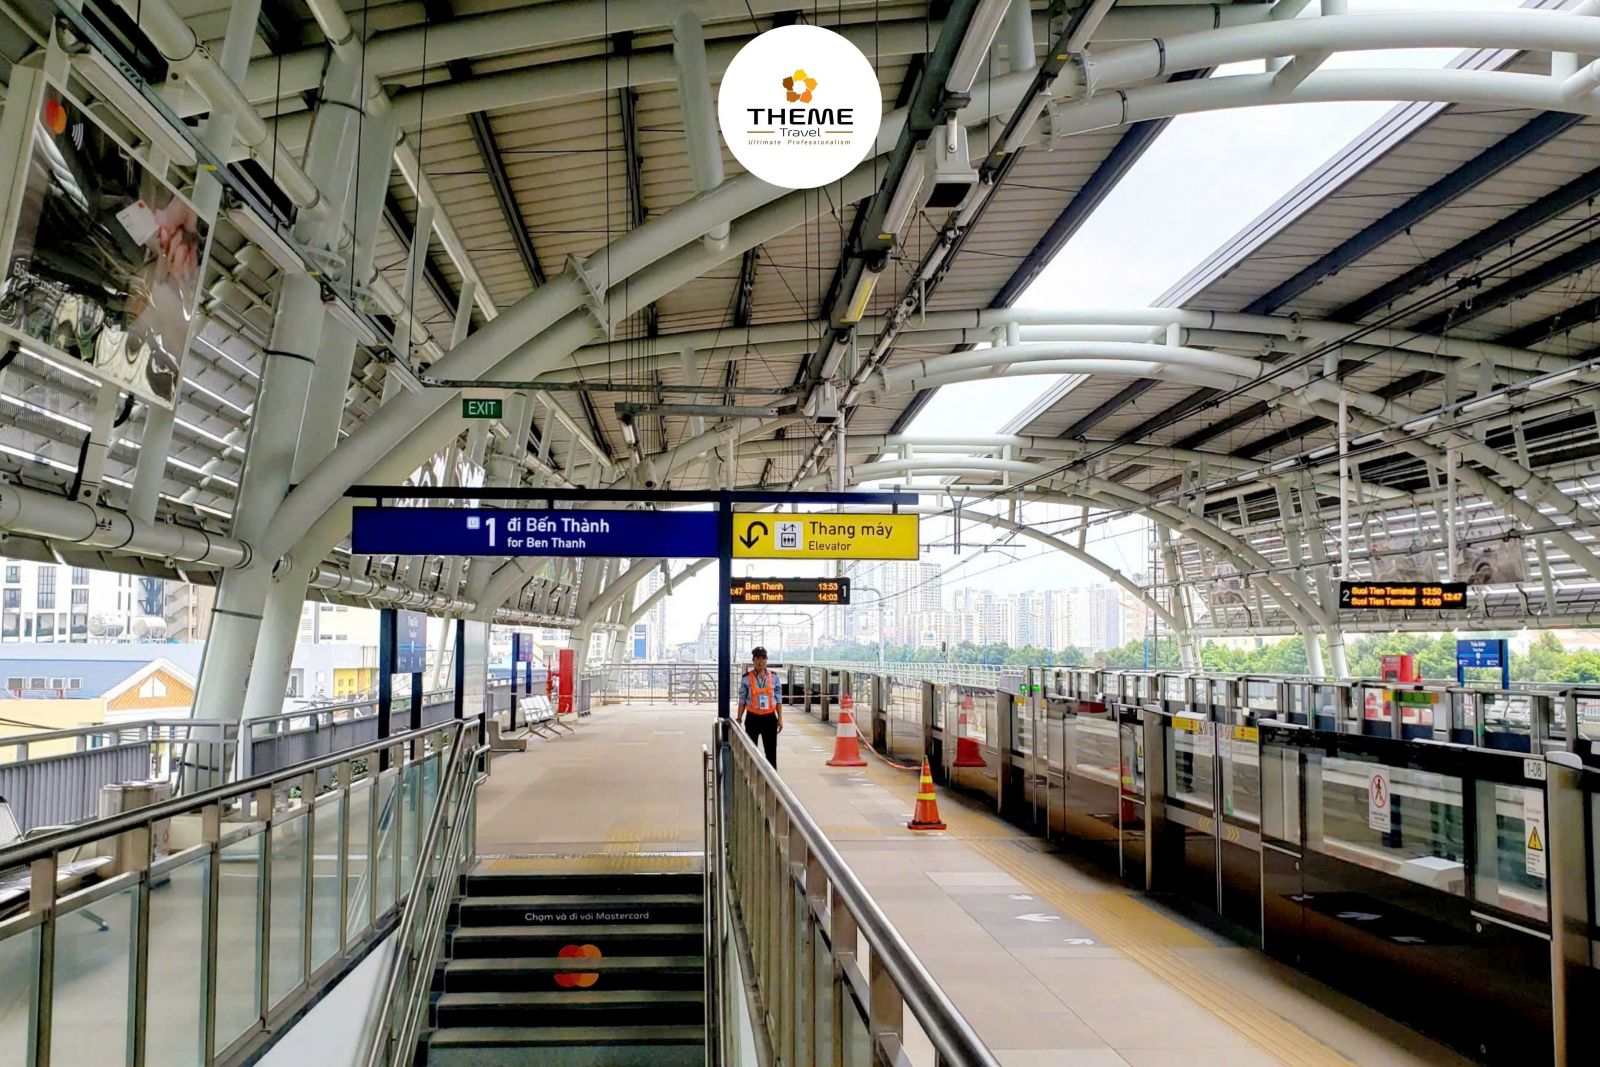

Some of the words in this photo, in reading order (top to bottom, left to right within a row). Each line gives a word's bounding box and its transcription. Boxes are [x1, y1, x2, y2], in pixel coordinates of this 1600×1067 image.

[468, 401, 496, 415] EXIT
[507, 517, 521, 532] đi
[526, 516, 557, 532] Bến
[561, 518, 610, 533] Thành
[809, 521, 855, 538] Thang
[861, 521, 893, 539] máy
[485, 517, 496, 547] 1
[507, 537, 523, 548] for
[526, 537, 548, 548] Ben
[551, 537, 586, 548] Thanh
[808, 541, 852, 551] Elevator
[745, 582, 760, 591] Ben
[761, 582, 784, 591] Thanh
[818, 583, 838, 591] 13:53
[842, 585, 847, 598] 1
[1369, 587, 1385, 595] Tien
[1386, 587, 1416, 595] Terminal
[745, 593, 760, 601] Ben
[761, 593, 784, 601] Thanh
[818, 593, 838, 601] 14:03
[1342, 589, 1350, 602] 2
[1369, 597, 1385, 606] Tien
[1385, 597, 1416, 606] Terminal
[1421, 598, 1442, 606] 14:00
[1527, 763, 1542, 777] 1-08
[524, 912, 553, 922] Chạm
[556, 912, 567, 921] và
[569, 912, 578, 921] đi
[595, 911, 649, 921] Mastercard
